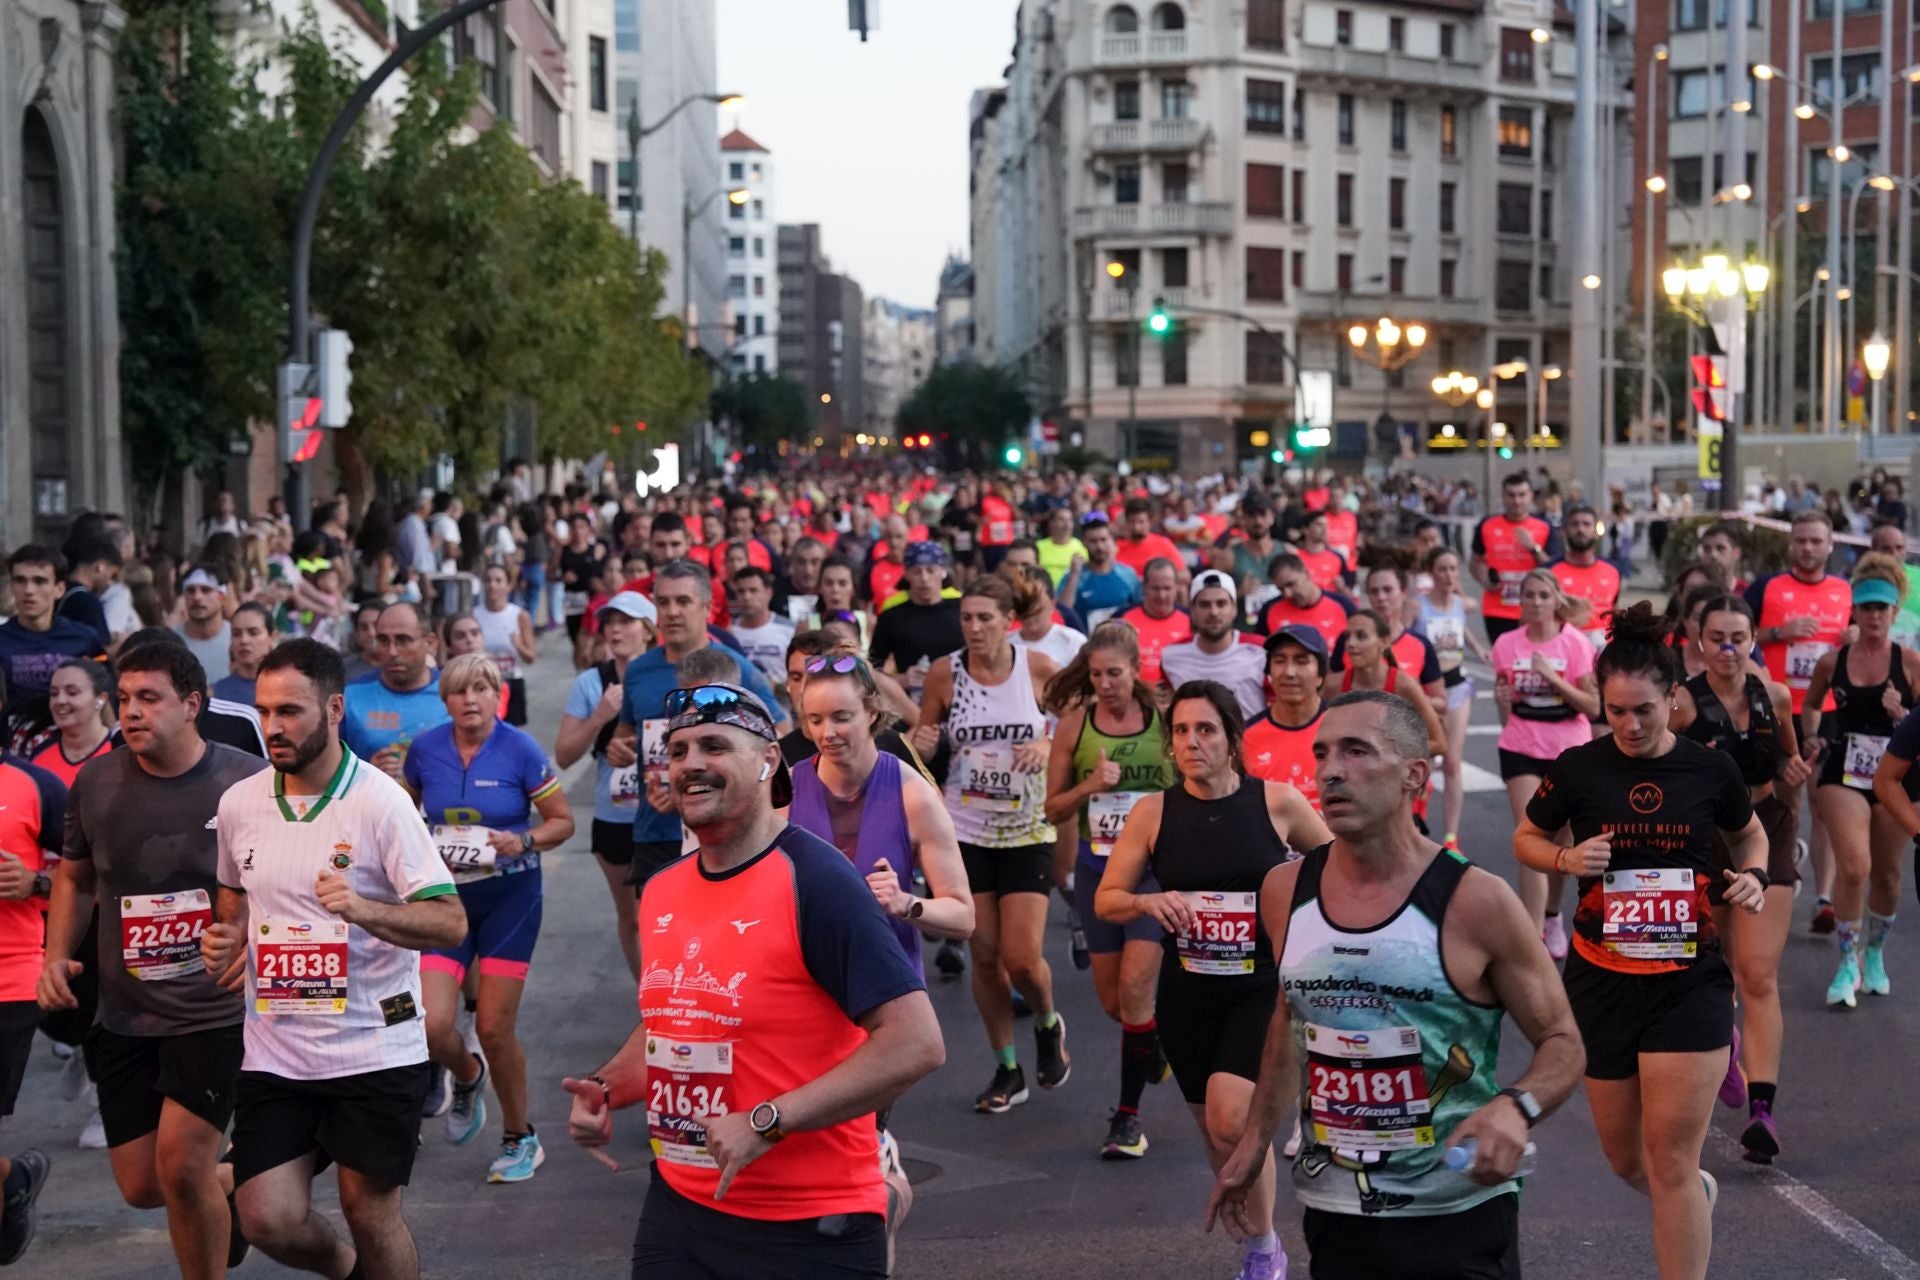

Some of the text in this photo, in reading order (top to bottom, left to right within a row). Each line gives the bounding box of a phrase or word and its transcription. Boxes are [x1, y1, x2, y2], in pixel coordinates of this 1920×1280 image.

[970, 769, 1011, 786] 3690
[1656, 823, 1690, 834] MEJOR
[1609, 899, 1690, 923] 22118
[128, 919, 208, 948] 22424
[263, 953, 340, 977] 21838
[1314, 1067, 1415, 1103] 23181
[650, 1079, 728, 1118] 21634
[1353, 1106, 1401, 1117] MIZUNO
[1421, 1132, 1429, 1142] 5
